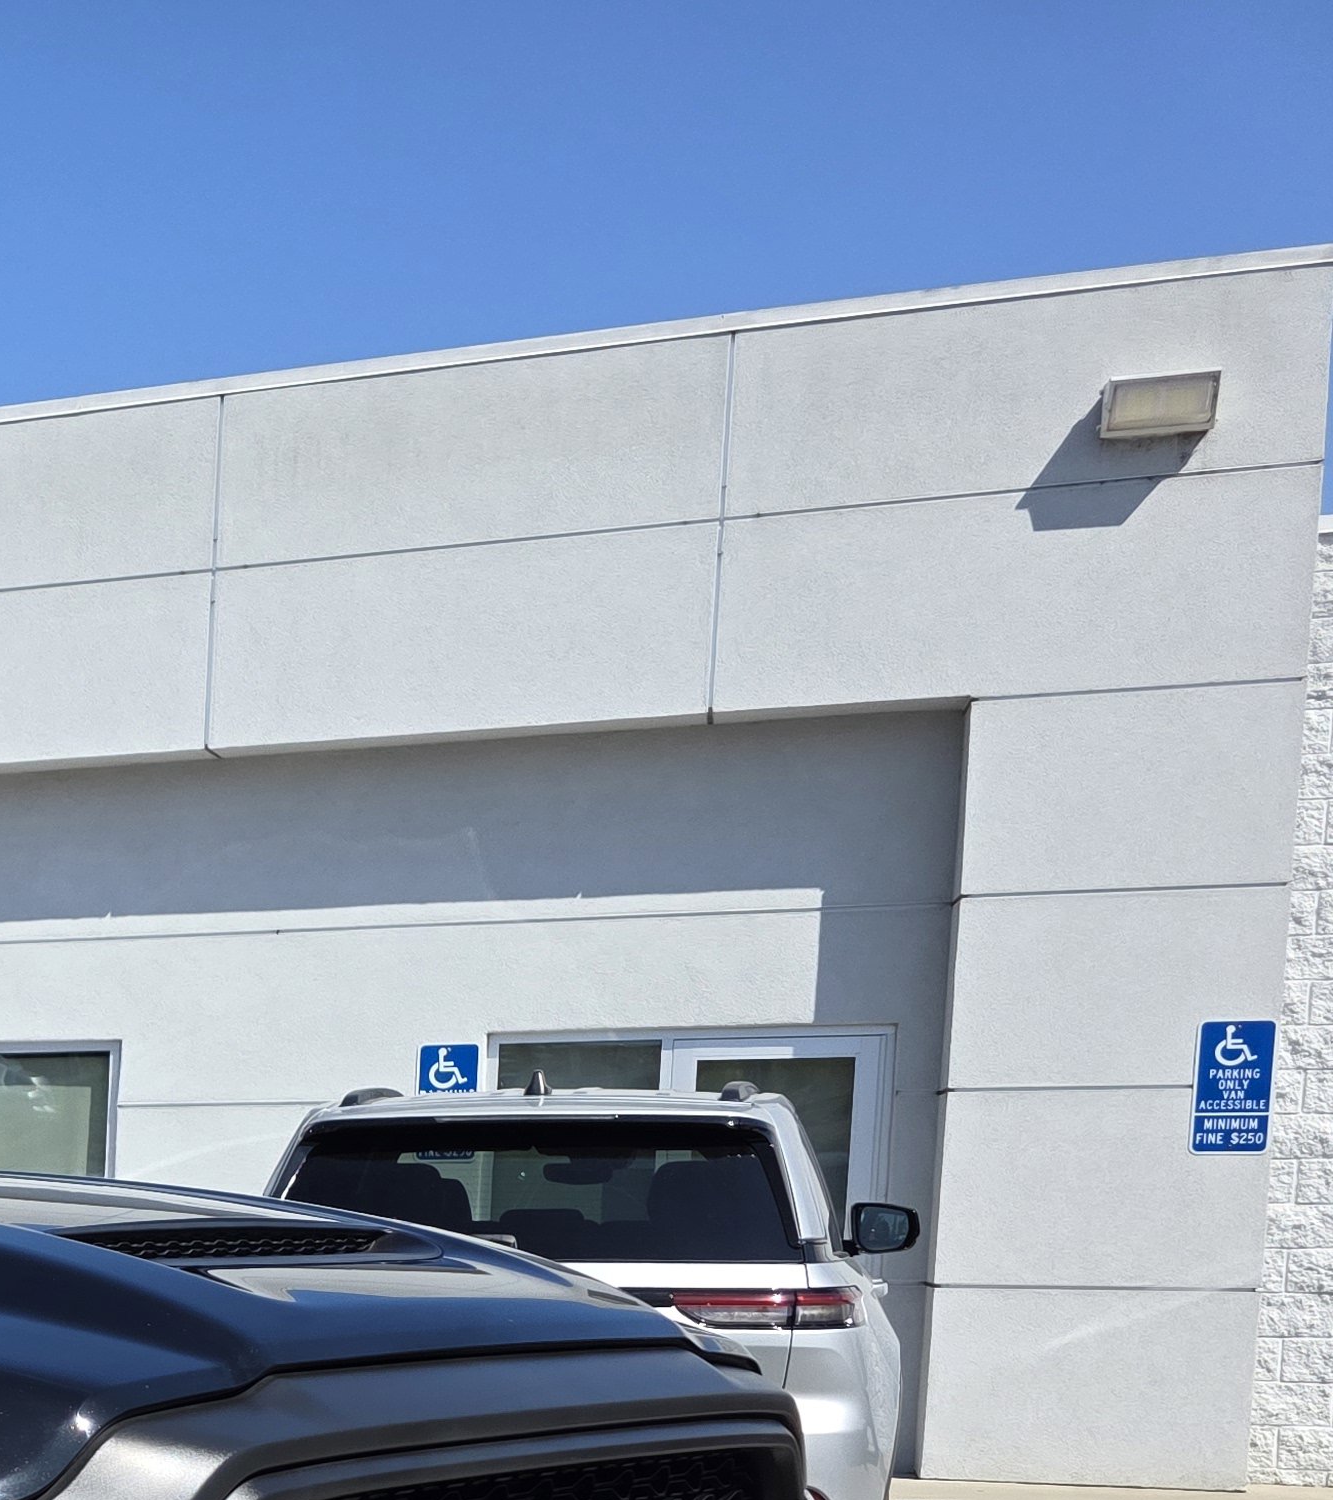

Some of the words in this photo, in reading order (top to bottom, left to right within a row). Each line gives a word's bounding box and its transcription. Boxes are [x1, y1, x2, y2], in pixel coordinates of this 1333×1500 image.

[1209, 1068, 1261, 1079] PARKING
[1218, 1079, 1250, 1090] ONLY
[1222, 1090, 1245, 1100] VAN
[1198, 1099, 1266, 1110] ACCESSIBLE
[1203, 1118, 1258, 1130] MINIMUM
[1195, 1132, 1225, 1144] FINE
[1230, 1132, 1264, 1145] $250
